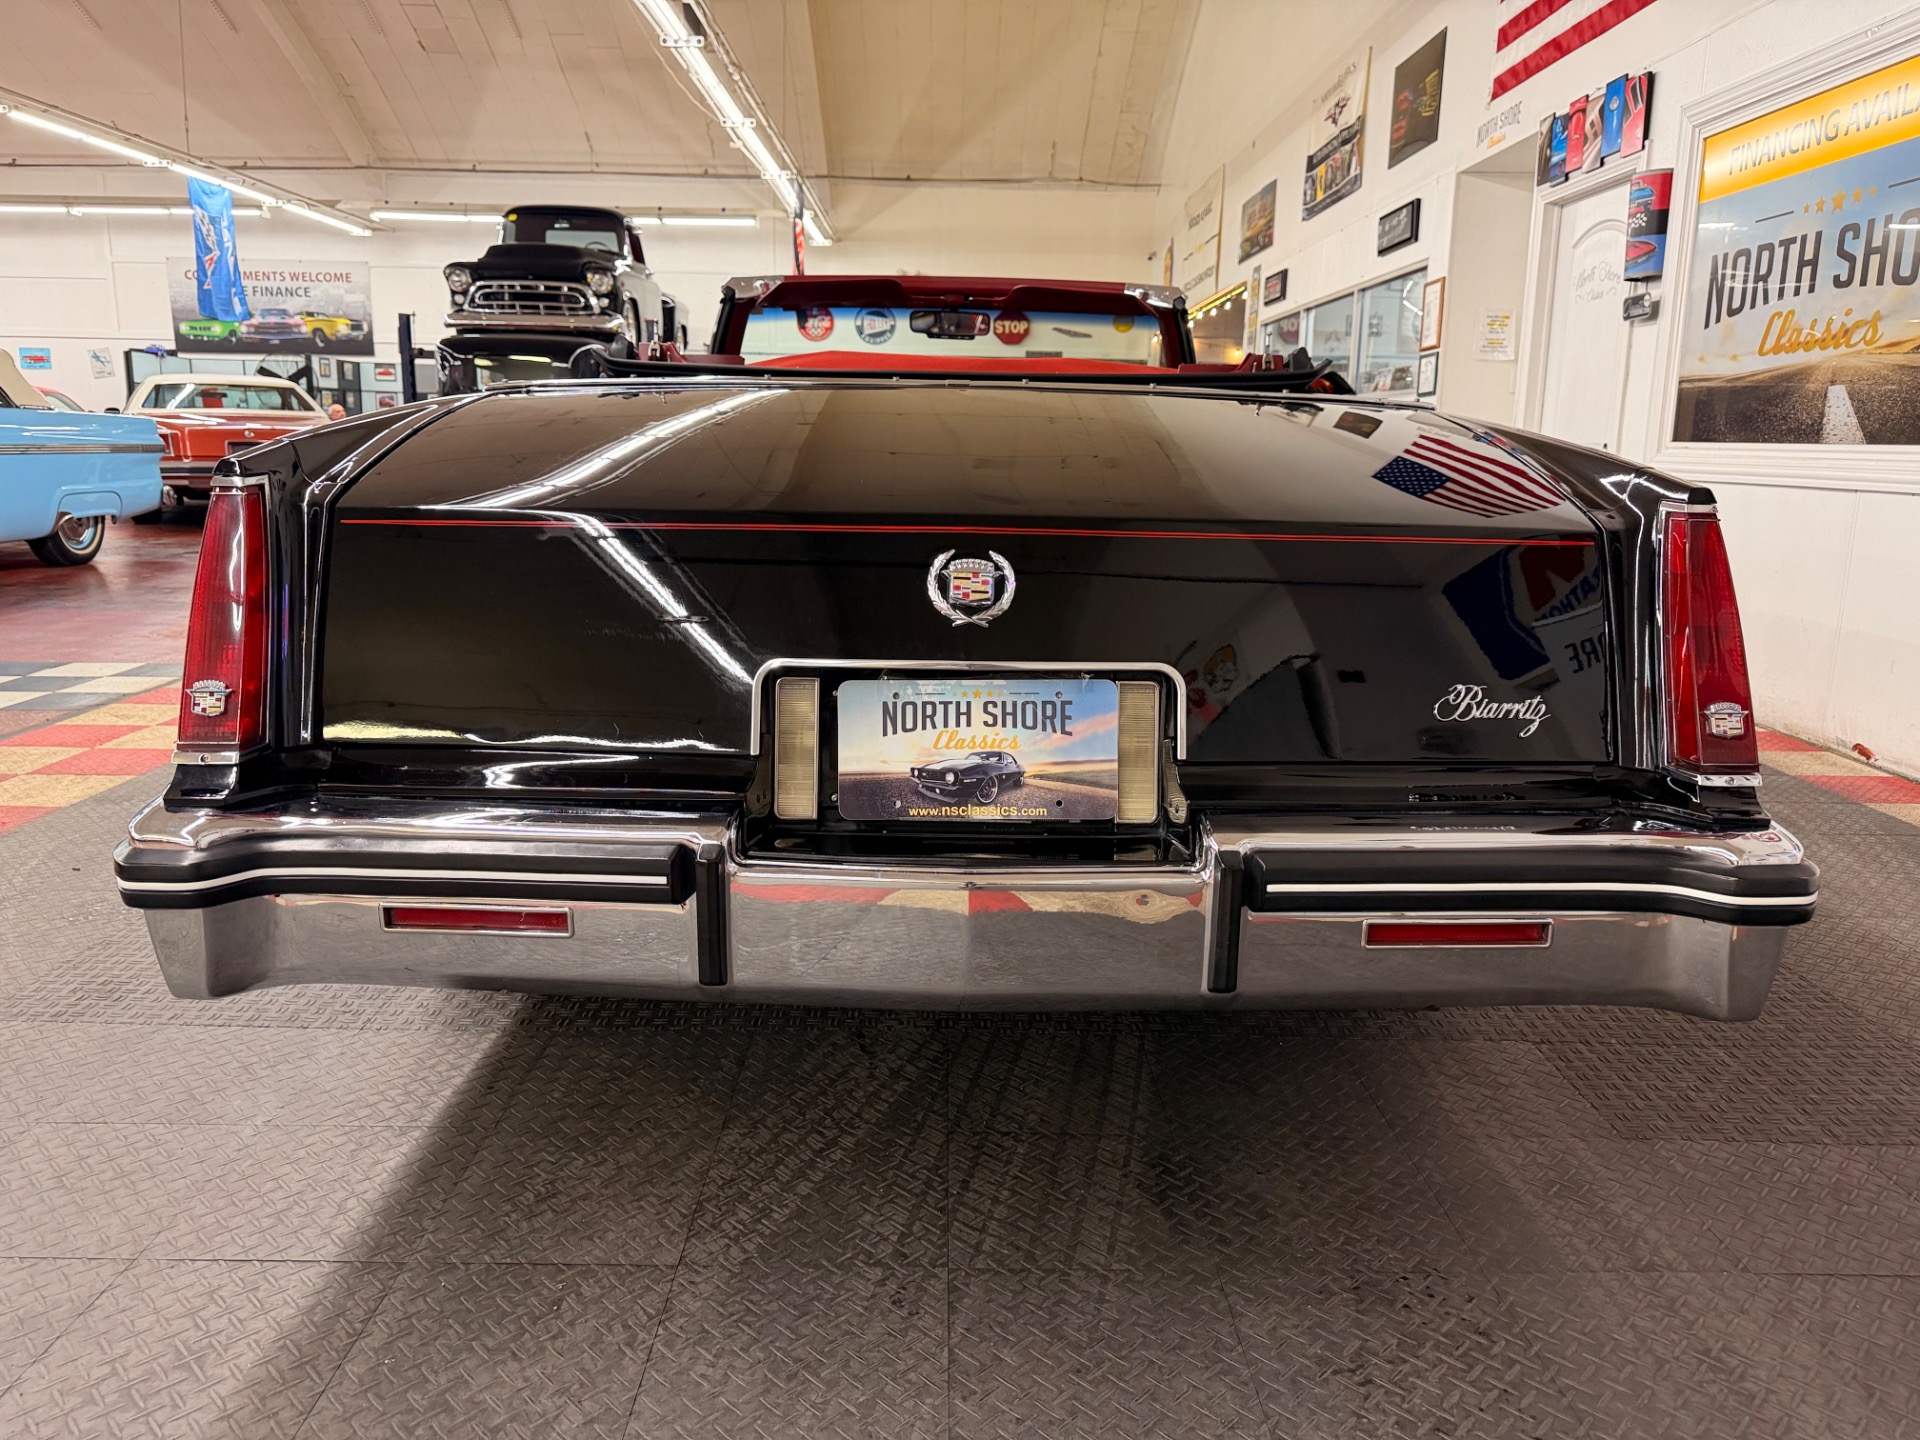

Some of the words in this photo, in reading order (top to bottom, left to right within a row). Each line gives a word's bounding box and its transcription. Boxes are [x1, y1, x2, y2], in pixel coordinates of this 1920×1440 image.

[1728, 108, 1841, 176] FINANCING
[289, 271, 352, 283] WELCOME
[1703, 229, 1823, 330] NORTH
[252, 286, 311, 298] FINANCE
[994, 320, 1029, 334] STOP
[1757, 307, 1885, 358] Classics
[882, 700, 972, 737] NORTH
[982, 700, 1073, 737] SHORE
[1433, 683, 1551, 738] Biarritz
[932, 729, 1021, 751] Classics
[908, 803, 1048, 816] www.nsclassics.com
